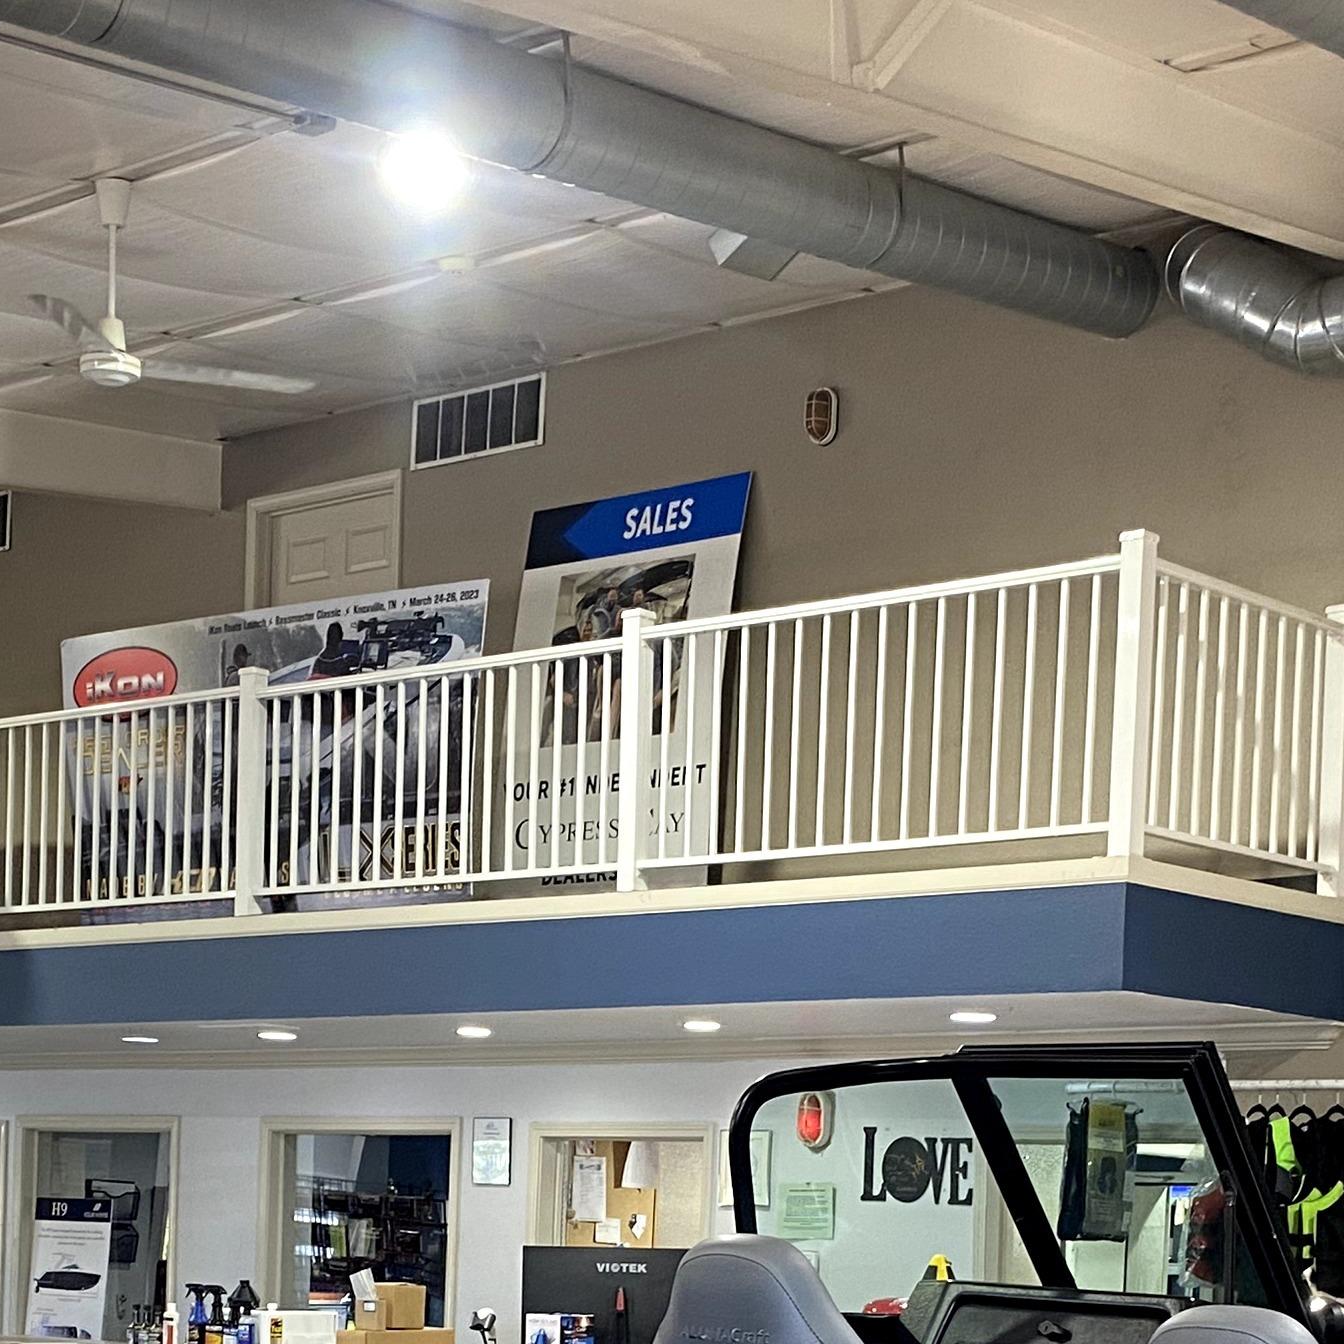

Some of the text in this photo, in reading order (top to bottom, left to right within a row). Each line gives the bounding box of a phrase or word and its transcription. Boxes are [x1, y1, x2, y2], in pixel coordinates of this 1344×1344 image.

[623, 497, 694, 540] SALES
[316, 608, 341, 620] Classic
[387, 599, 397, 610] TN
[409, 595, 432, 606] March
[459, 589, 480, 600] 2023
[860, 1126, 973, 1206] LOVE
[51, 1202, 68, 1217] H9
[596, 1262, 647, 1273] VIOTEK
